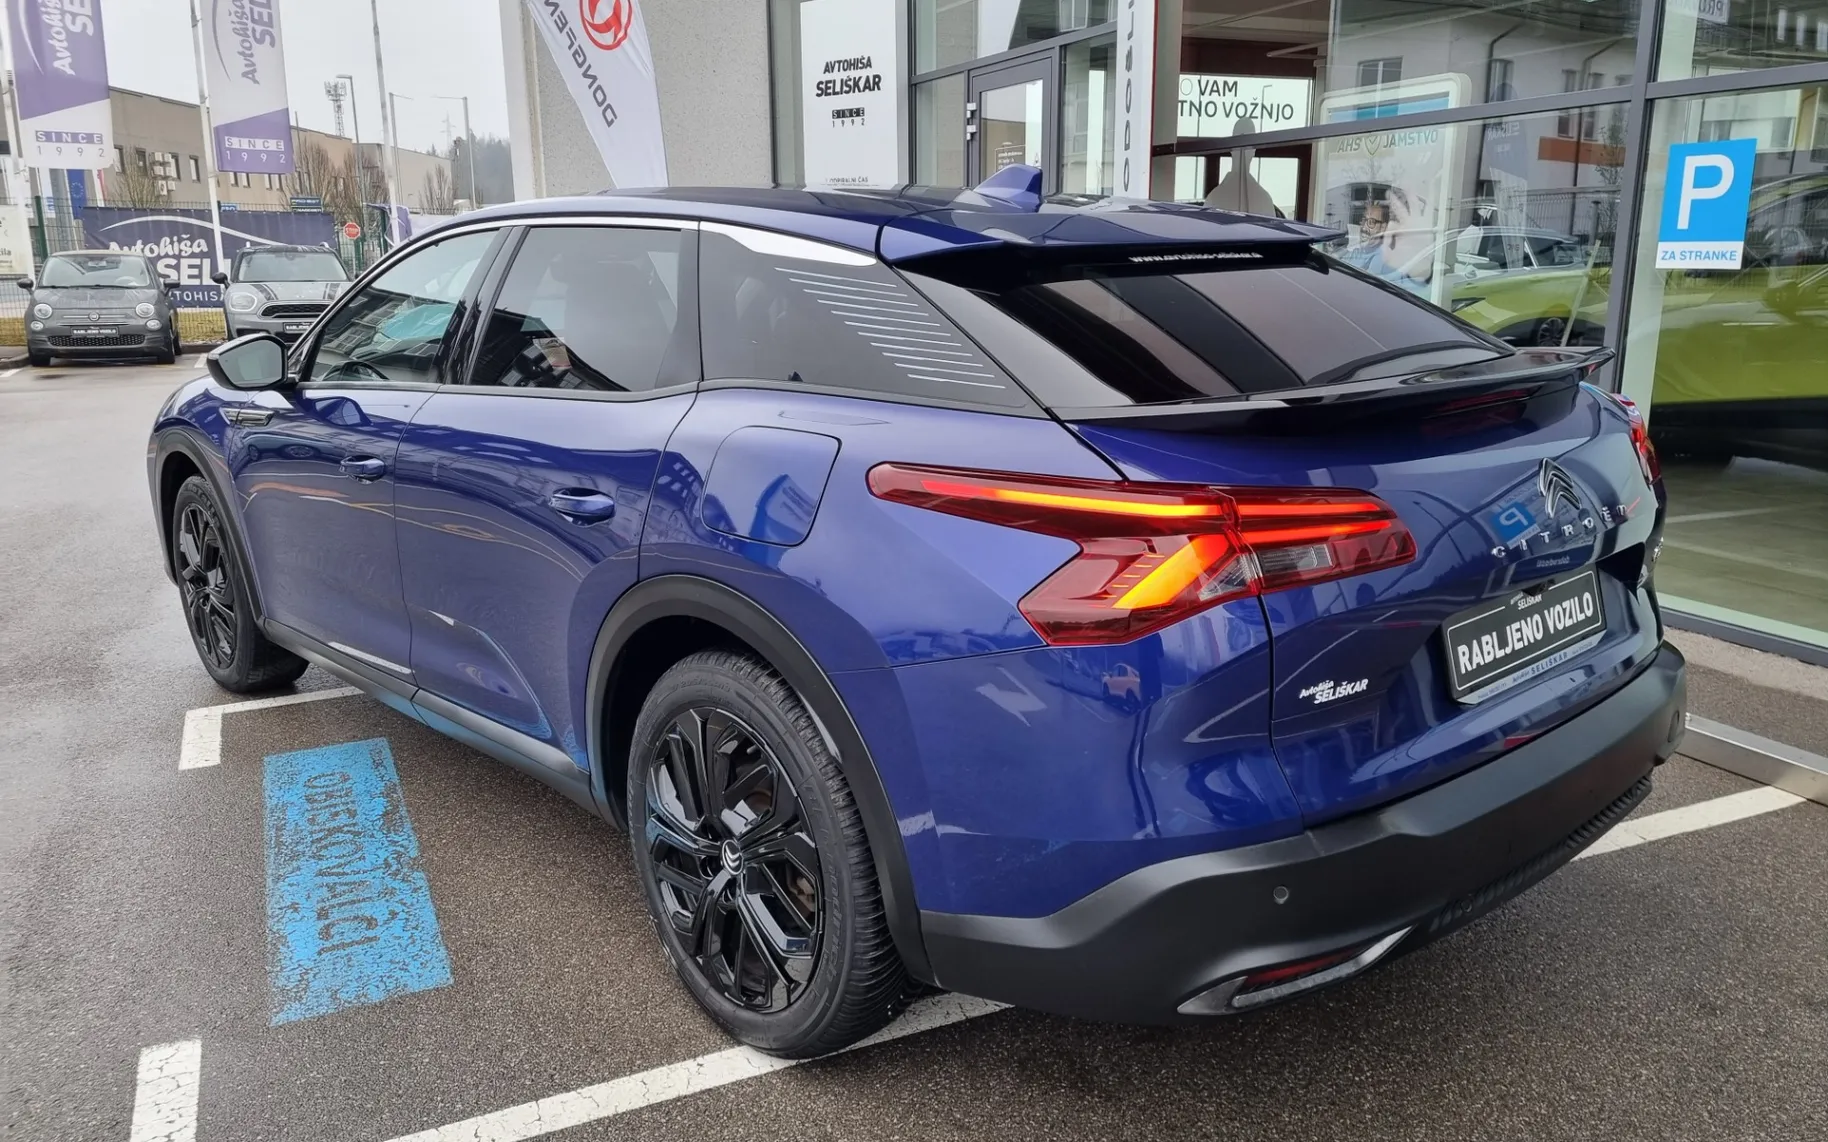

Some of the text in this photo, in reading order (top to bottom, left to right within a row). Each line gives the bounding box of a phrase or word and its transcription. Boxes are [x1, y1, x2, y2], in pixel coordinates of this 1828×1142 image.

[823, 55, 872, 75] AVTOHIŠA
[815, 74, 882, 98] SELIŠKAR
[1197, 80, 1238, 97] VAM
[832, 107, 865, 119] SINCE
[1222, 97, 1294, 123] VOŽNJO
[832, 118, 865, 128] 1992
[36, 131, 102, 144] SINCE
[226, 137, 284, 150] SINCE
[1337, 129, 1440, 153] AHS JAMSTVO
[36, 145, 105, 158] 1992
[226, 150, 286, 164] 1992
[1677, 154, 1735, 230] P
[1661, 250, 1737, 261] ZA STRANKE
[1457, 591, 1594, 675] RABLJENO VOZILO
[1314, 678, 1369, 705] SELIŠKAR
